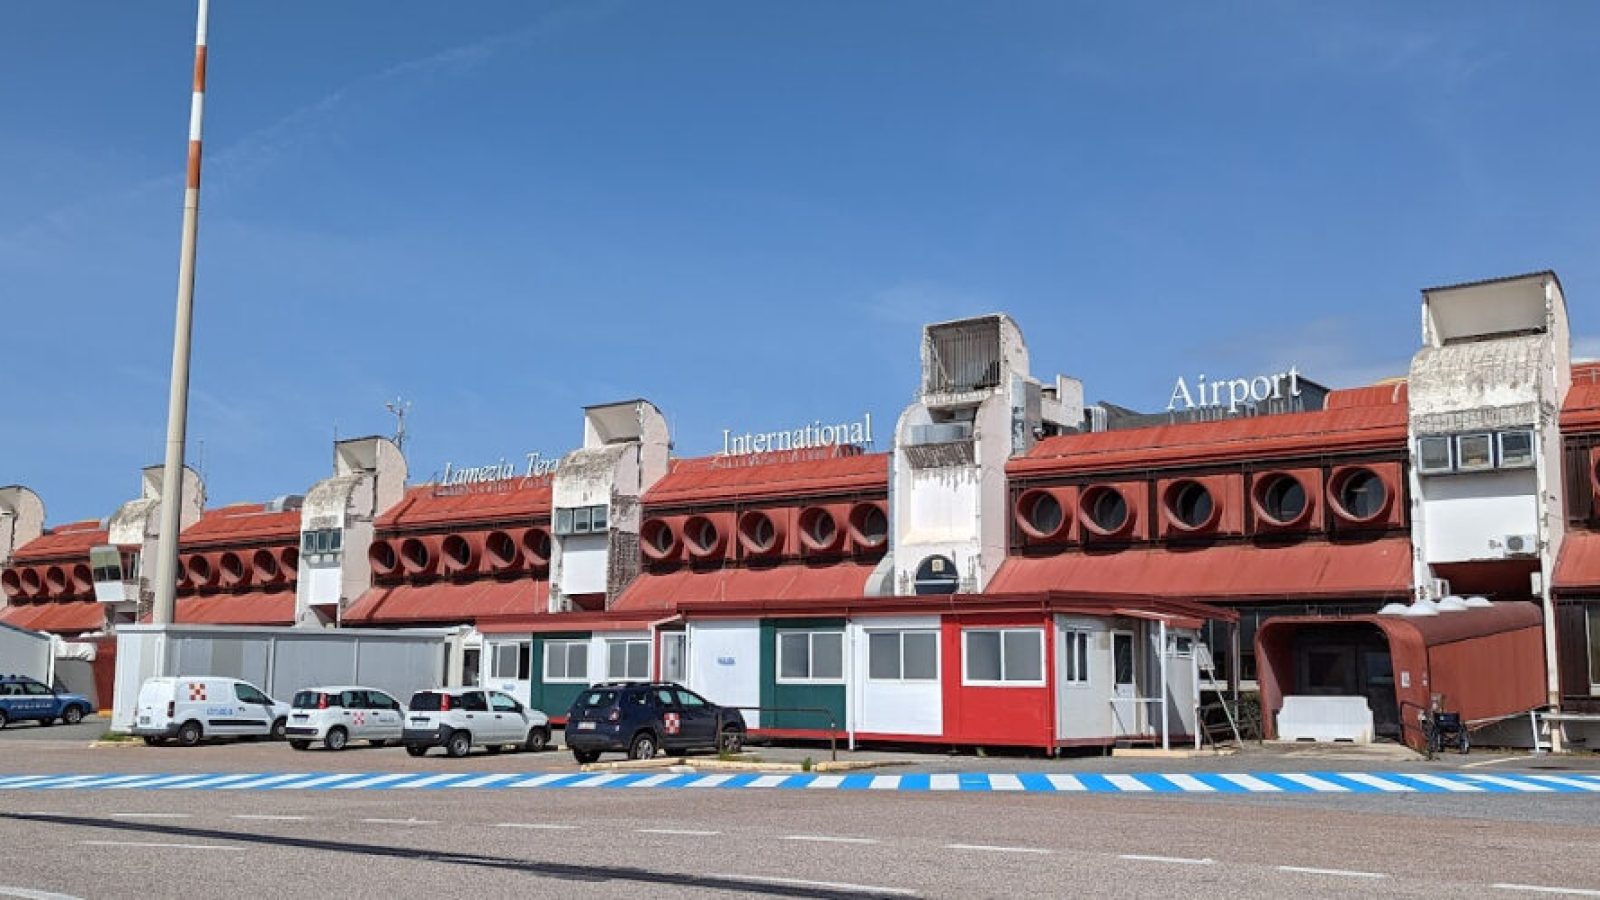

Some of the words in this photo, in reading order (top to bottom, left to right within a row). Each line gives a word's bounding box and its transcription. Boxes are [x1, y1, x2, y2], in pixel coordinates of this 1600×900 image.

[1167, 364, 1302, 413] Airport
[723, 412, 872, 456] International
[443, 458, 514, 486] Lamezia
